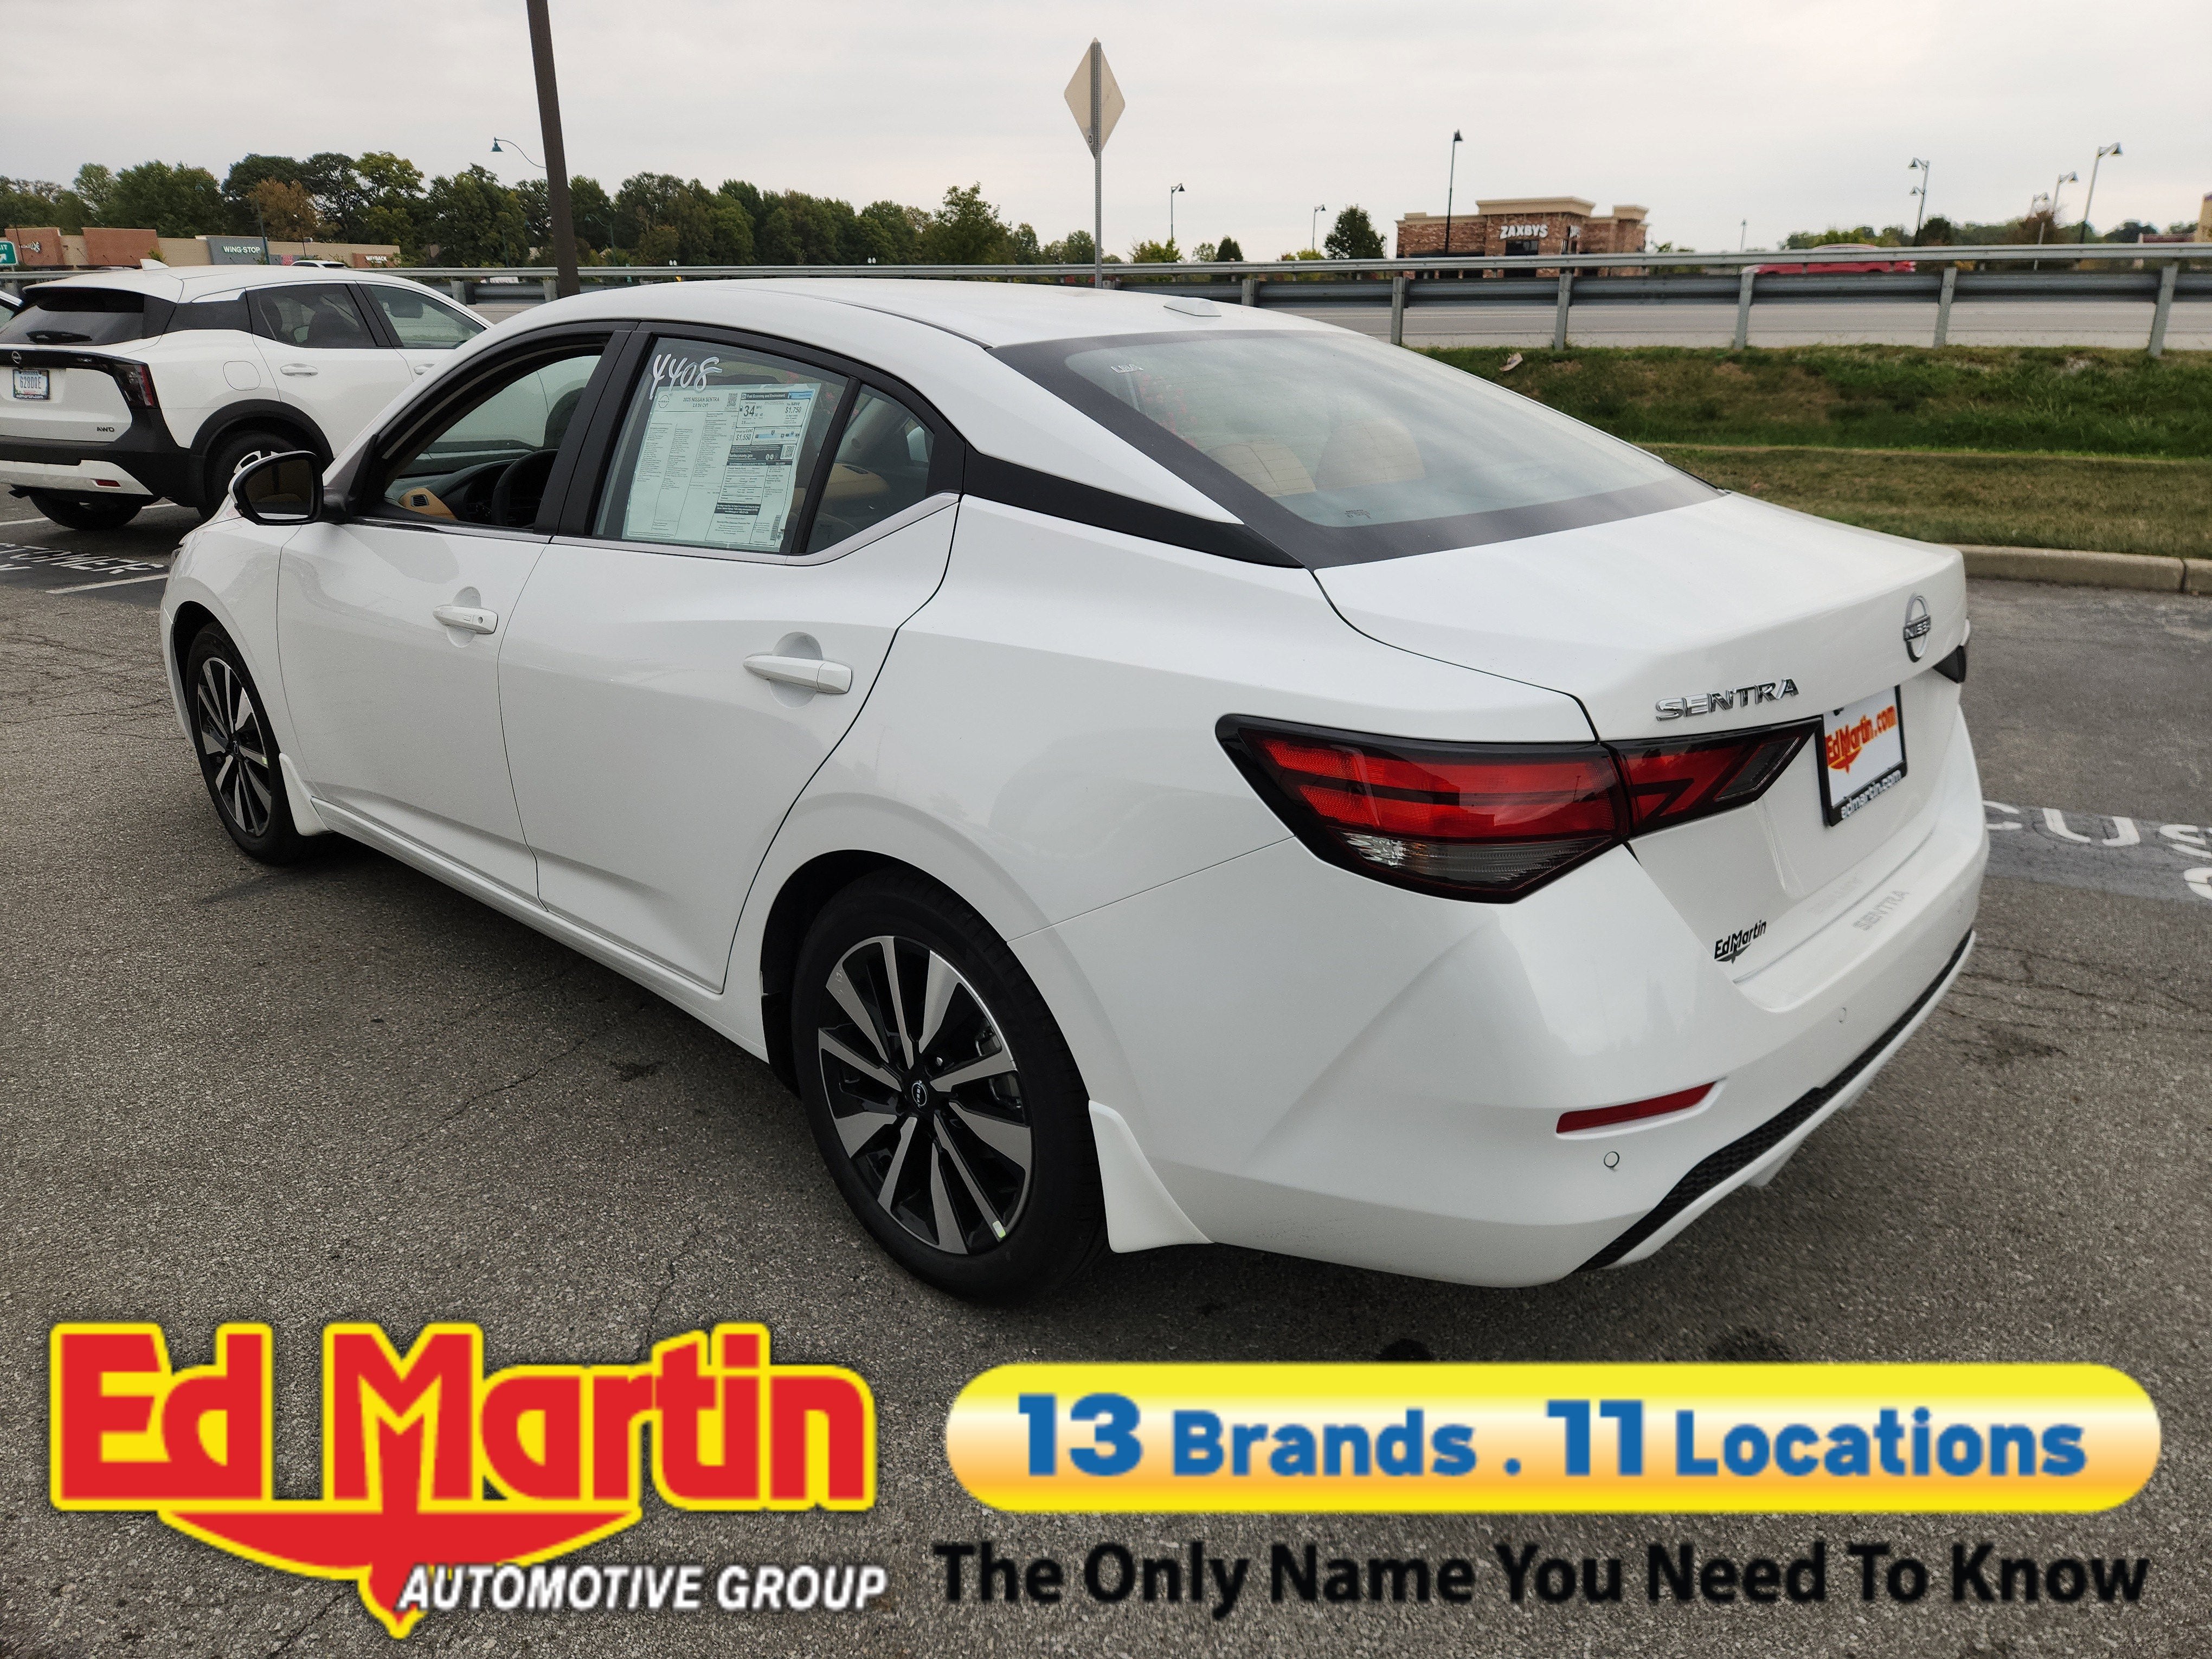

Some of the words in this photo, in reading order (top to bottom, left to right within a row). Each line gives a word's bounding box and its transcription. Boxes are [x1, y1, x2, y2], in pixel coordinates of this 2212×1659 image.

[649, 353, 723, 400] 4408
[743, 405, 755, 416] 34
[1655, 678, 1799, 722] SENTRA
